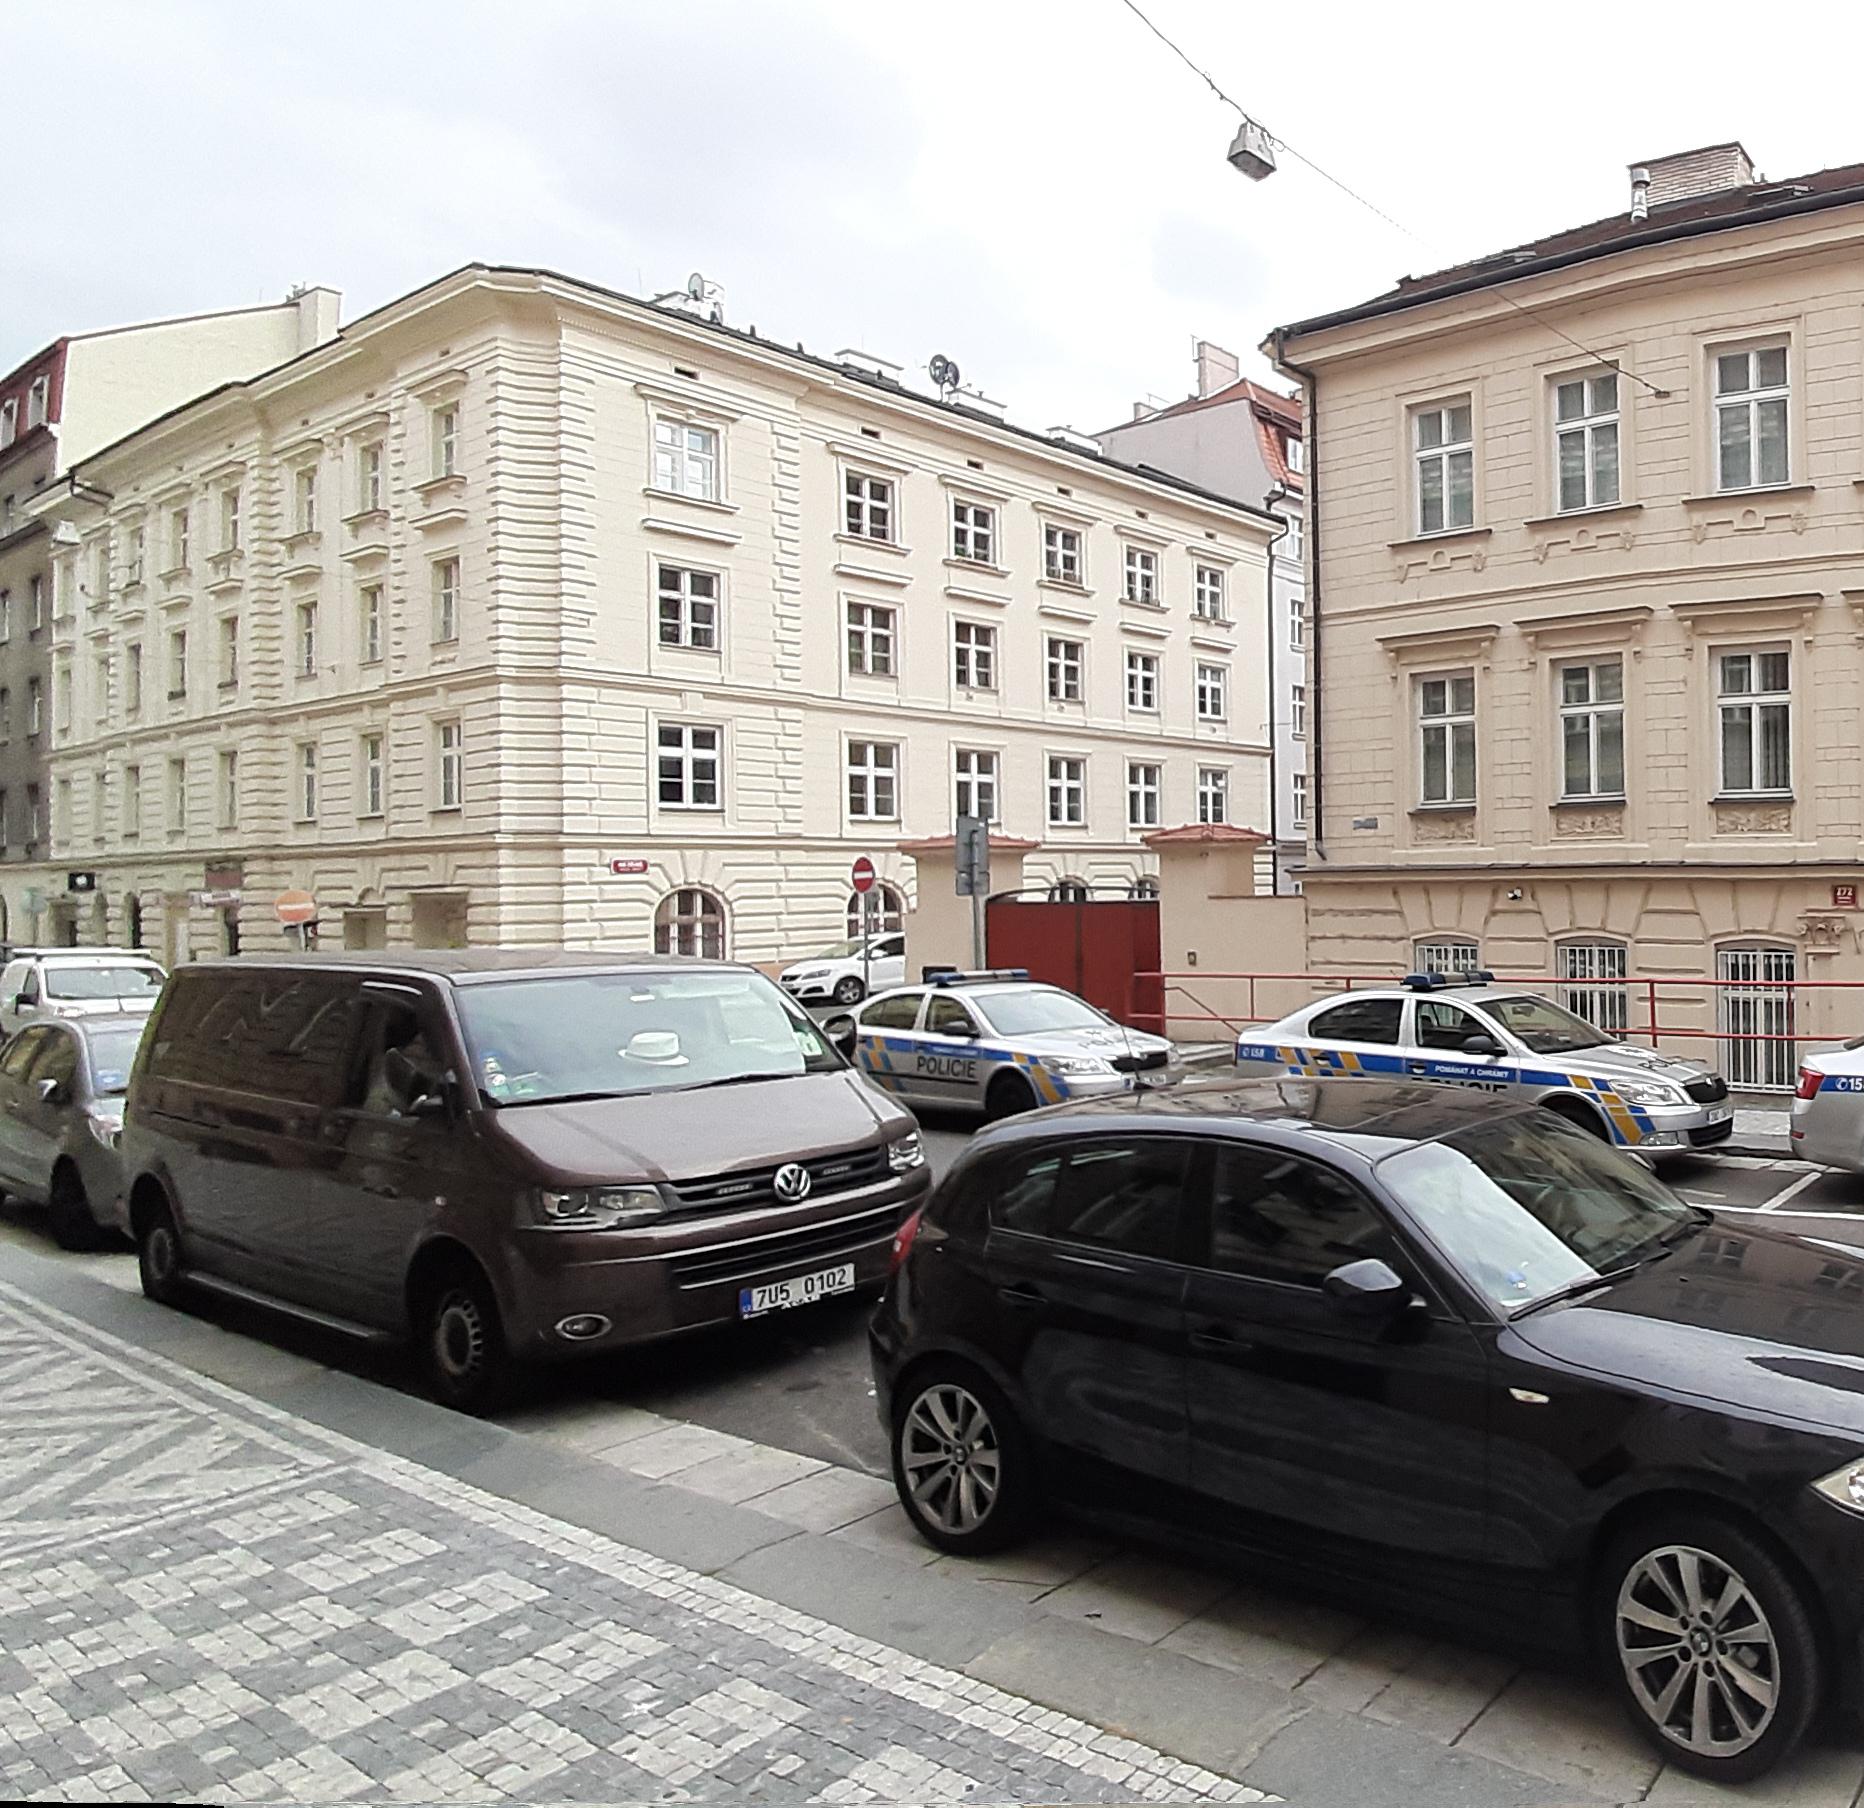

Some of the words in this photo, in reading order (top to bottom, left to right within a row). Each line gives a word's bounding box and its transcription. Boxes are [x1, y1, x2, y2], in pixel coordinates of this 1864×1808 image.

[1250, 1048, 1265, 1058] 158
[917, 1056, 977, 1078] POLICIE
[756, 1283, 791, 1308] 7U5
[804, 1268, 847, 1294] 0102
